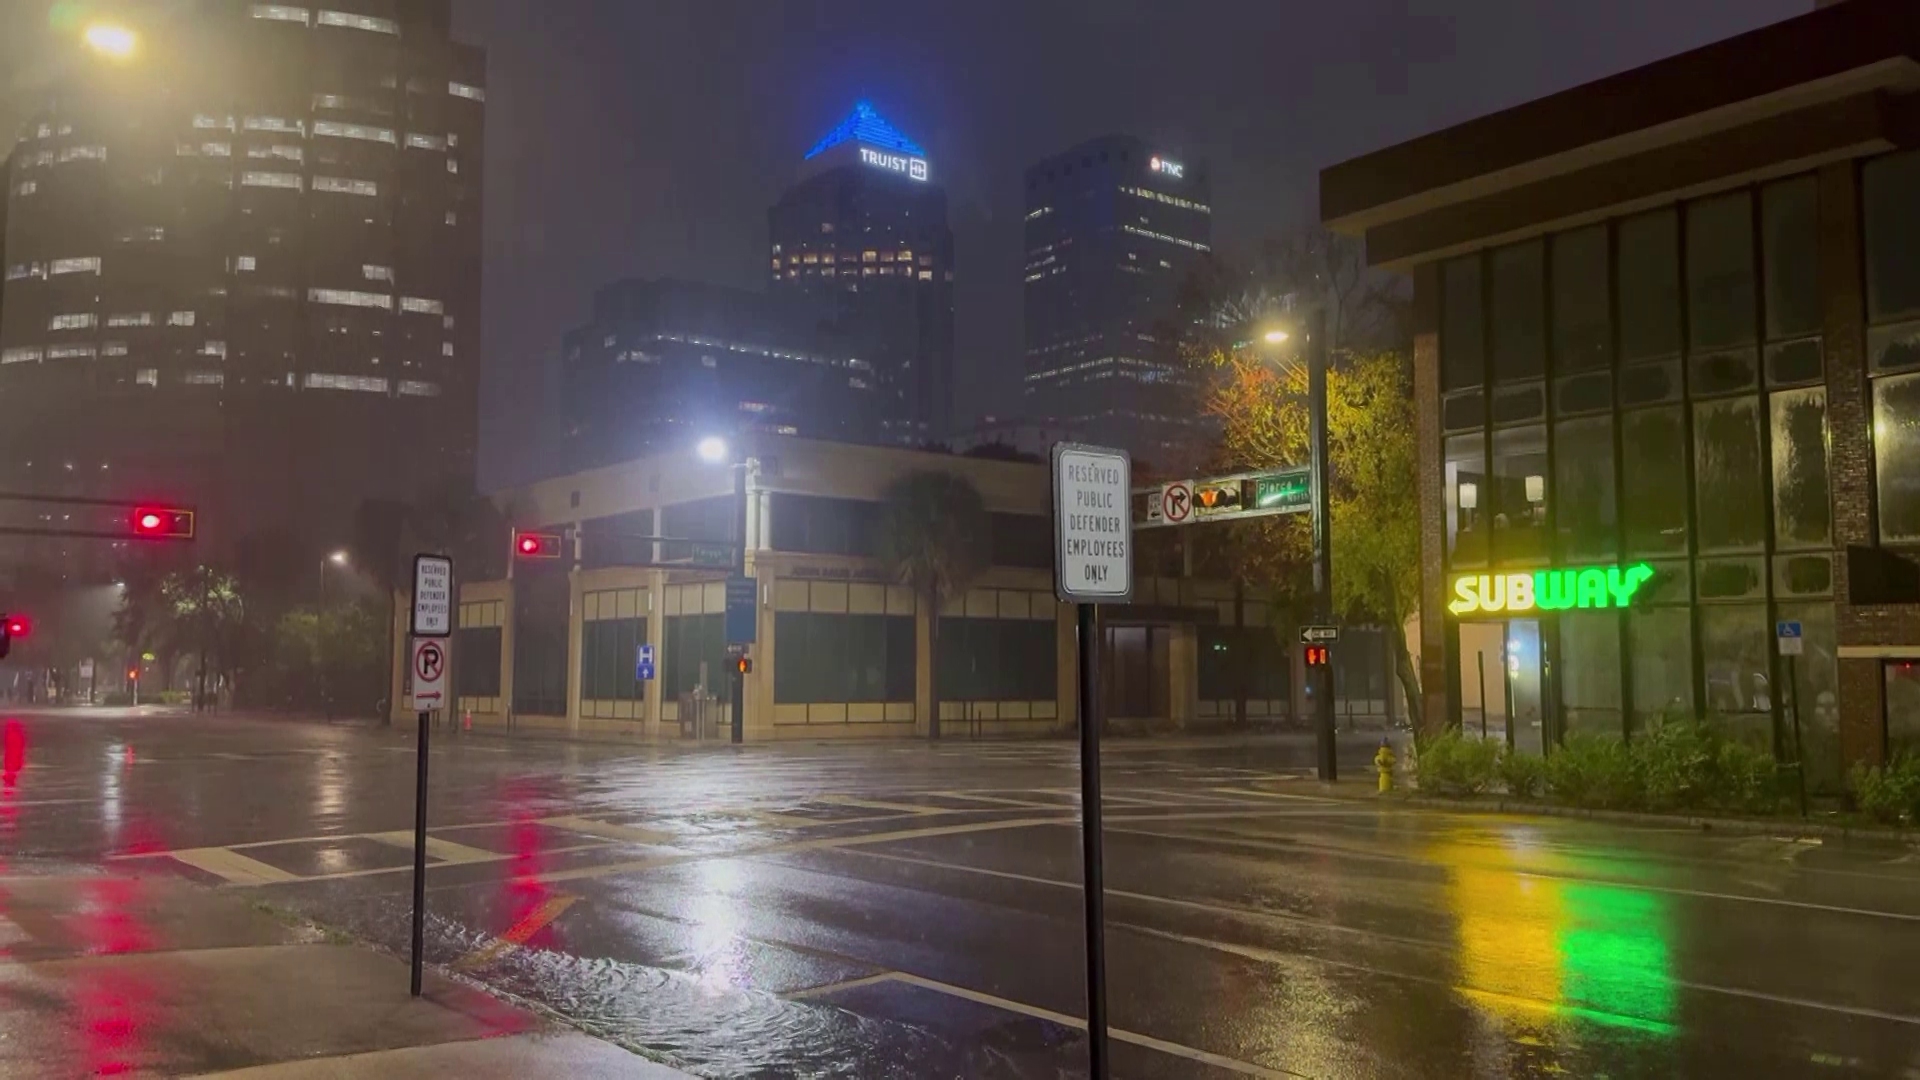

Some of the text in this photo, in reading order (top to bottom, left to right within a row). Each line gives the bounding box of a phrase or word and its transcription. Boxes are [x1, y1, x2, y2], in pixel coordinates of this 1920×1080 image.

[860, 147, 908, 173] TRUIST
[1068, 465, 1119, 485] RESERVED
[1258, 480, 1292, 495] Pierce
[1076, 491, 1113, 508] PUBLIC
[1069, 515, 1121, 533] DEFENDER
[1067, 539, 1124, 558] EMPLOYEES
[421, 565, 446, 576] RESERVED
[1084, 564, 1109, 581] ONLY
[424, 578, 443, 588] PUBLIC
[1448, 563, 1654, 616] SUBWAY
[420, 591, 446, 600] DEFENDER
[418, 603, 447, 614] EMPLOYEES
[639, 646, 653, 663] H
